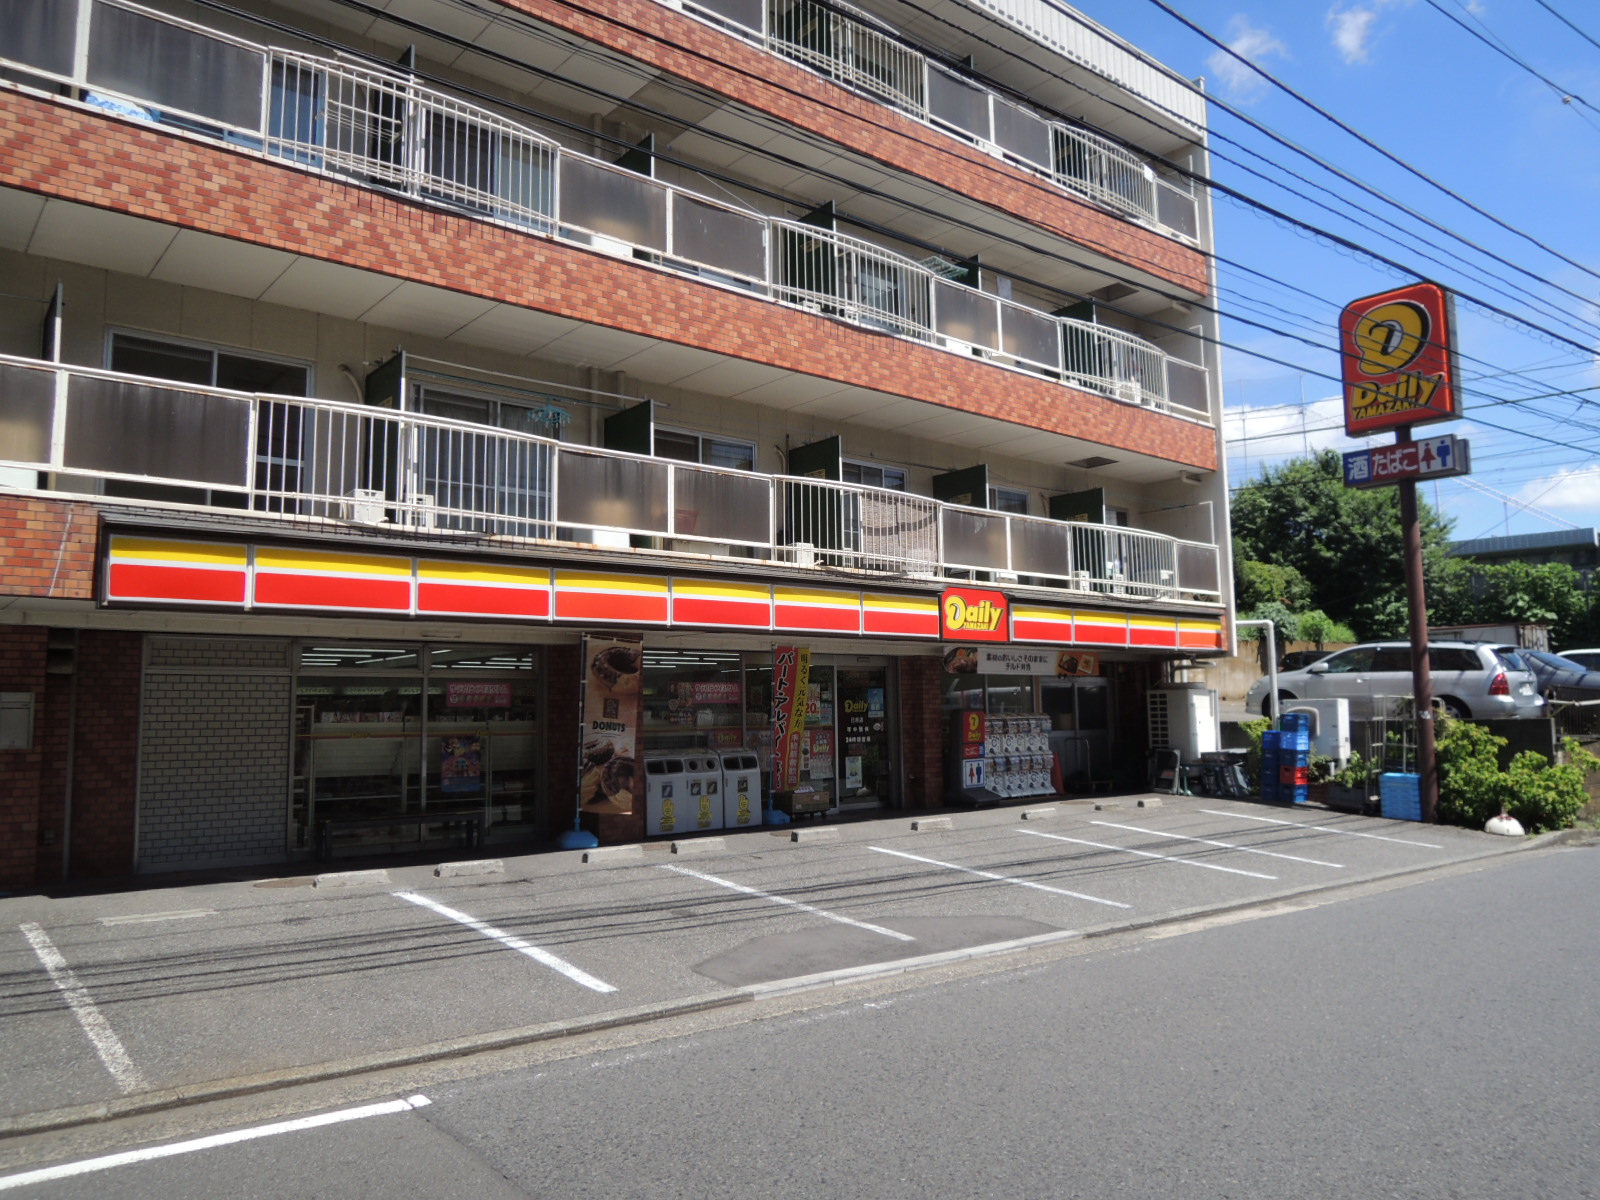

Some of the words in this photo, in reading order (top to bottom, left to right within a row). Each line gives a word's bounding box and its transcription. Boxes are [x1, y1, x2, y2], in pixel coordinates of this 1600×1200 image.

[1351, 371, 1444, 408] Daily
[1352, 399, 1419, 420] YAMAZAKI
[1348, 455, 1369, 480] 酒
[1373, 449, 1418, 476] たばこ
[945, 595, 1004, 630] Daily
[1005, 663, 1031, 671] チルド弁当
[793, 653, 808, 728] 明るく元気な方
[844, 699, 868, 713] Daily
[592, 720, 626, 732] DONUTS
